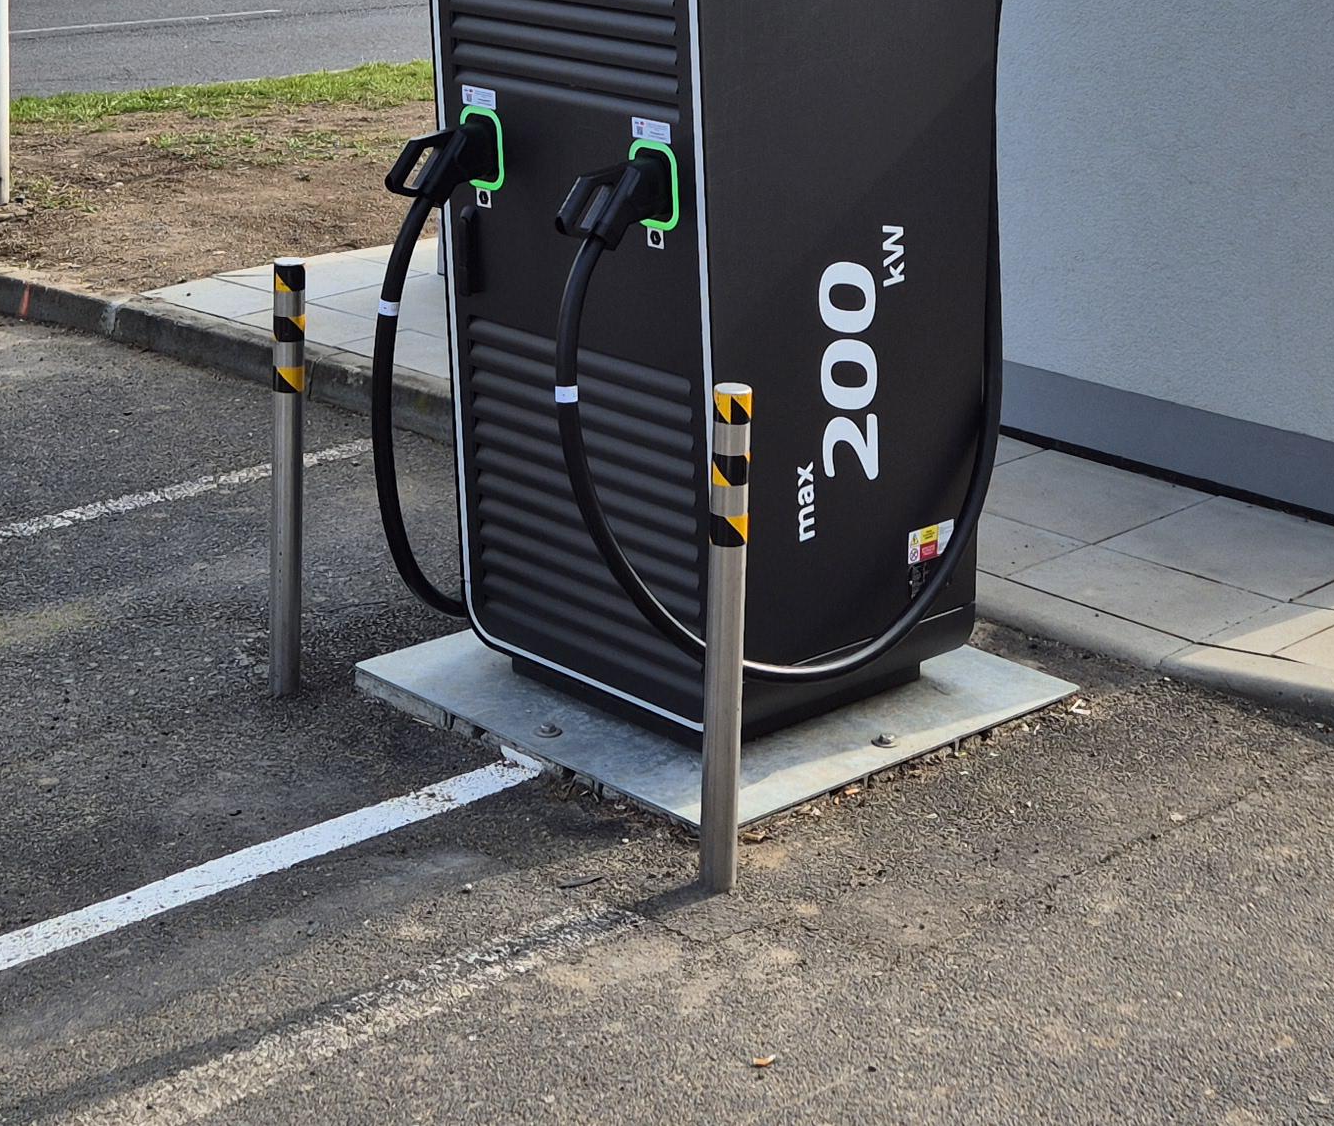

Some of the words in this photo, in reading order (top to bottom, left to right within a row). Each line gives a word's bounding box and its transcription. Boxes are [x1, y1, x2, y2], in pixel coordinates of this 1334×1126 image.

[797, 461, 816, 542] max
[818, 261, 879, 481] 200
[882, 225, 906, 287] kW
